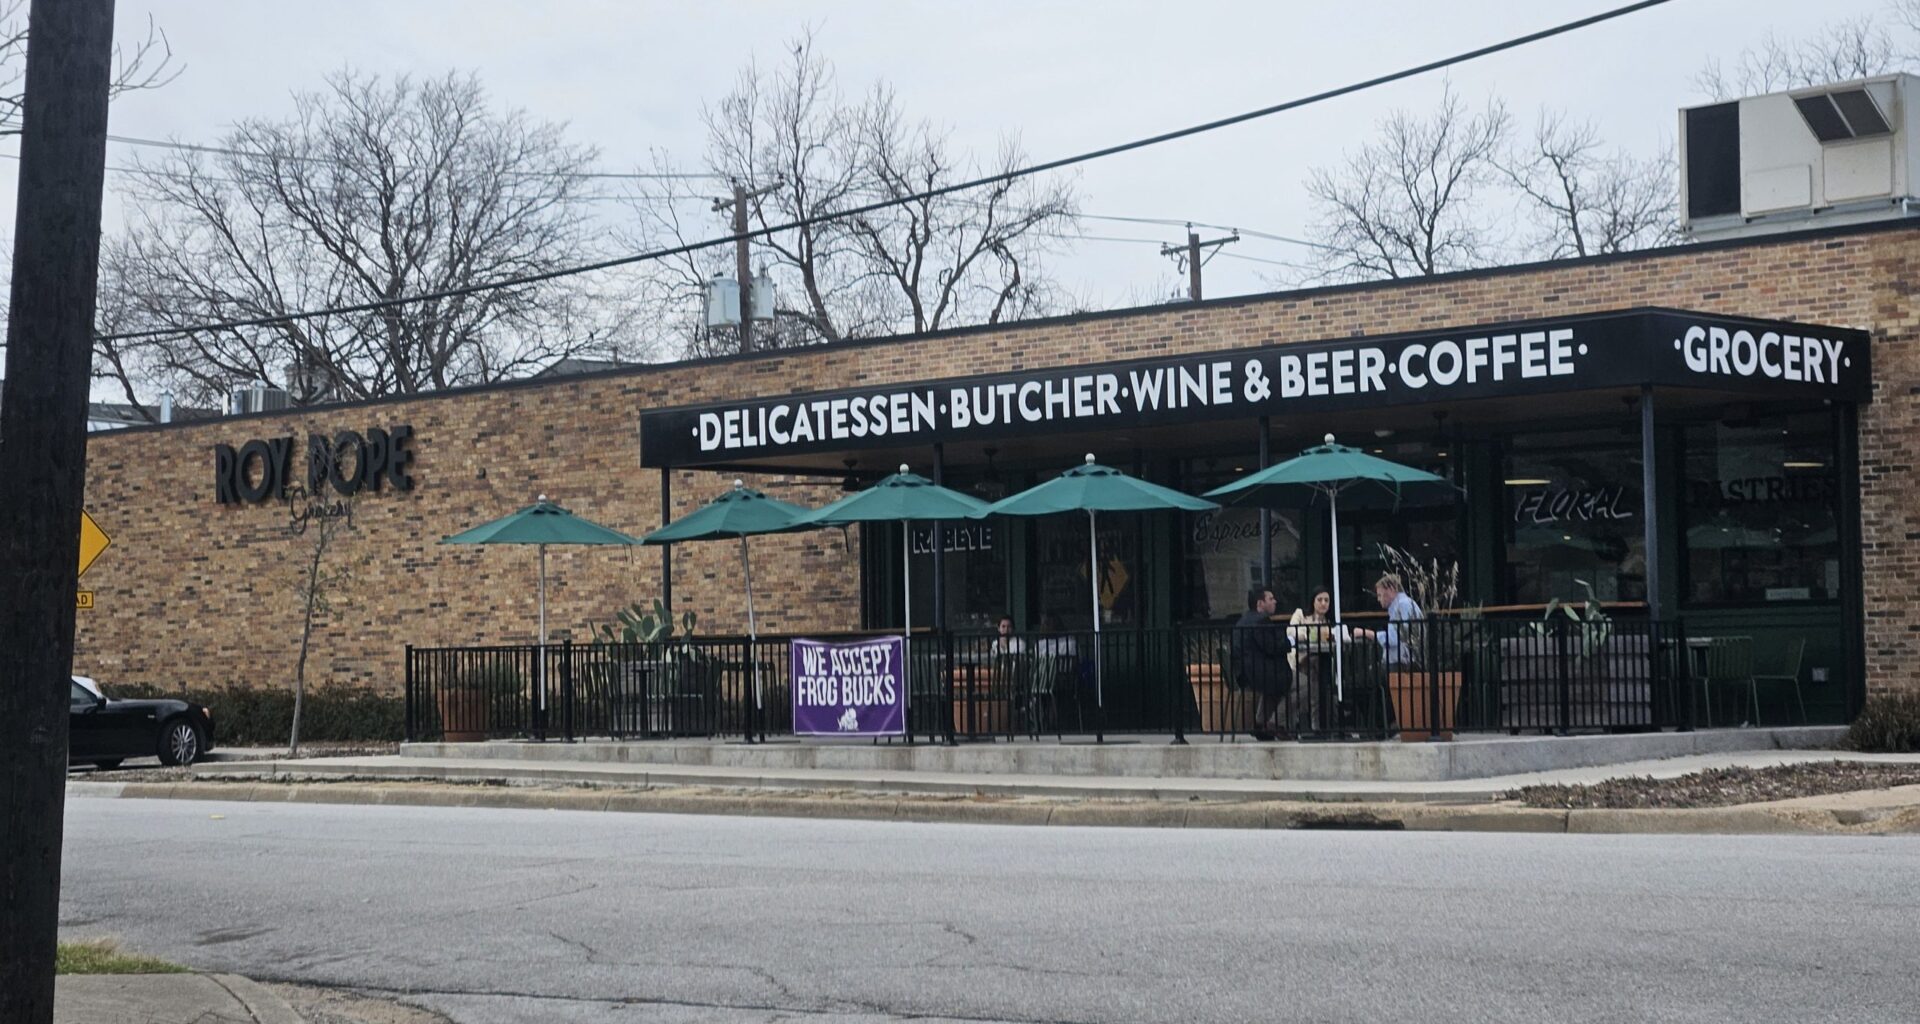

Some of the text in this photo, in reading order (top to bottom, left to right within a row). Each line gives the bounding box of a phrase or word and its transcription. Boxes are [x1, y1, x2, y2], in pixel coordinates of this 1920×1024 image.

[1684, 325, 1844, 385] GROCERY
[1243, 359, 1271, 403] &
[214, 424, 414, 504] ROY POPE
[1513, 485, 1633, 525] FLORAL
[1193, 511, 1281, 553] Espreso
[802, 643, 892, 676] WE ACCEPT
[798, 674, 896, 706] FROG BUCKS
